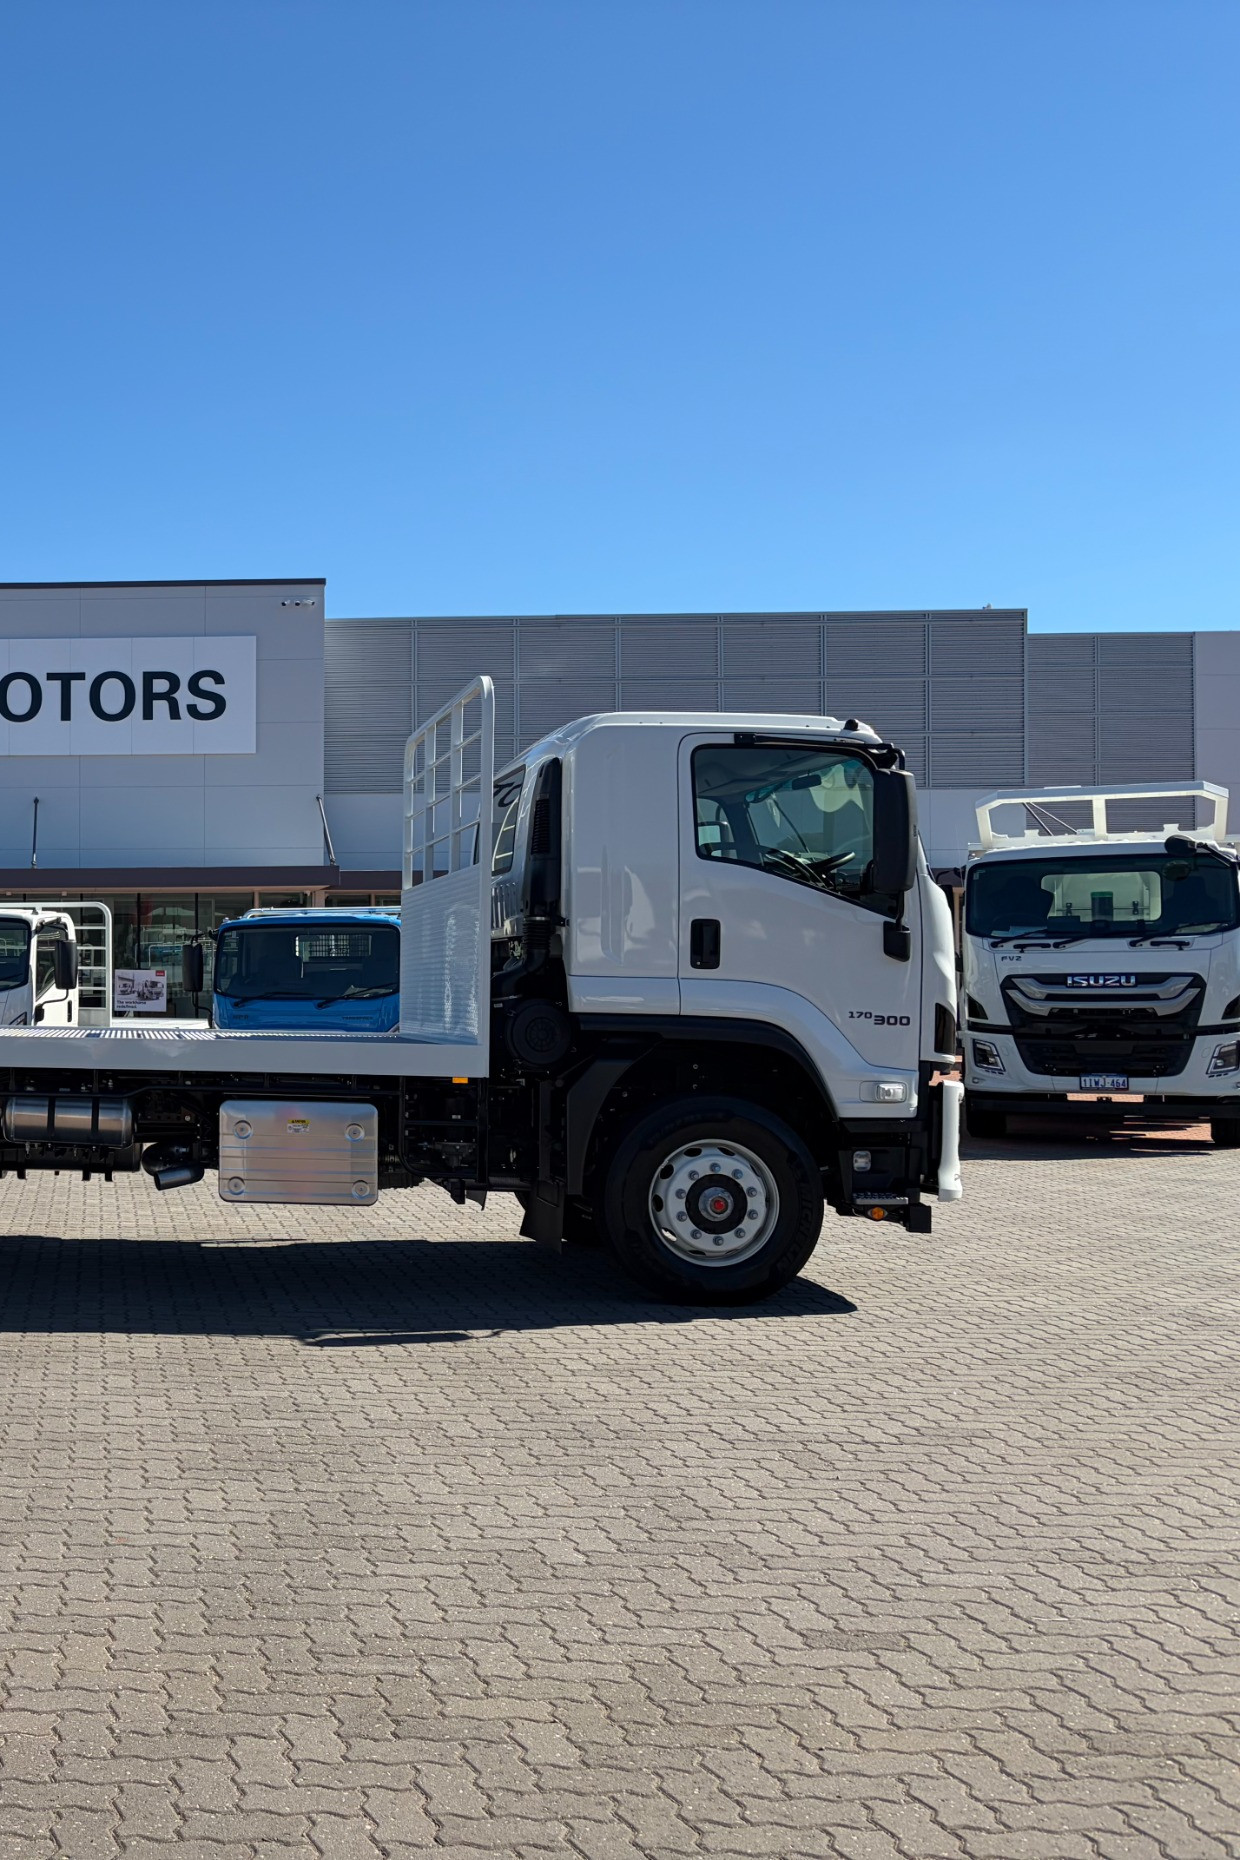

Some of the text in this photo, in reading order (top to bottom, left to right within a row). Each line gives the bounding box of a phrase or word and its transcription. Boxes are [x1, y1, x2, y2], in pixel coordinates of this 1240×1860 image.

[1067, 975, 1136, 987] ISUZU
[848, 1011, 911, 1026] 170 300
